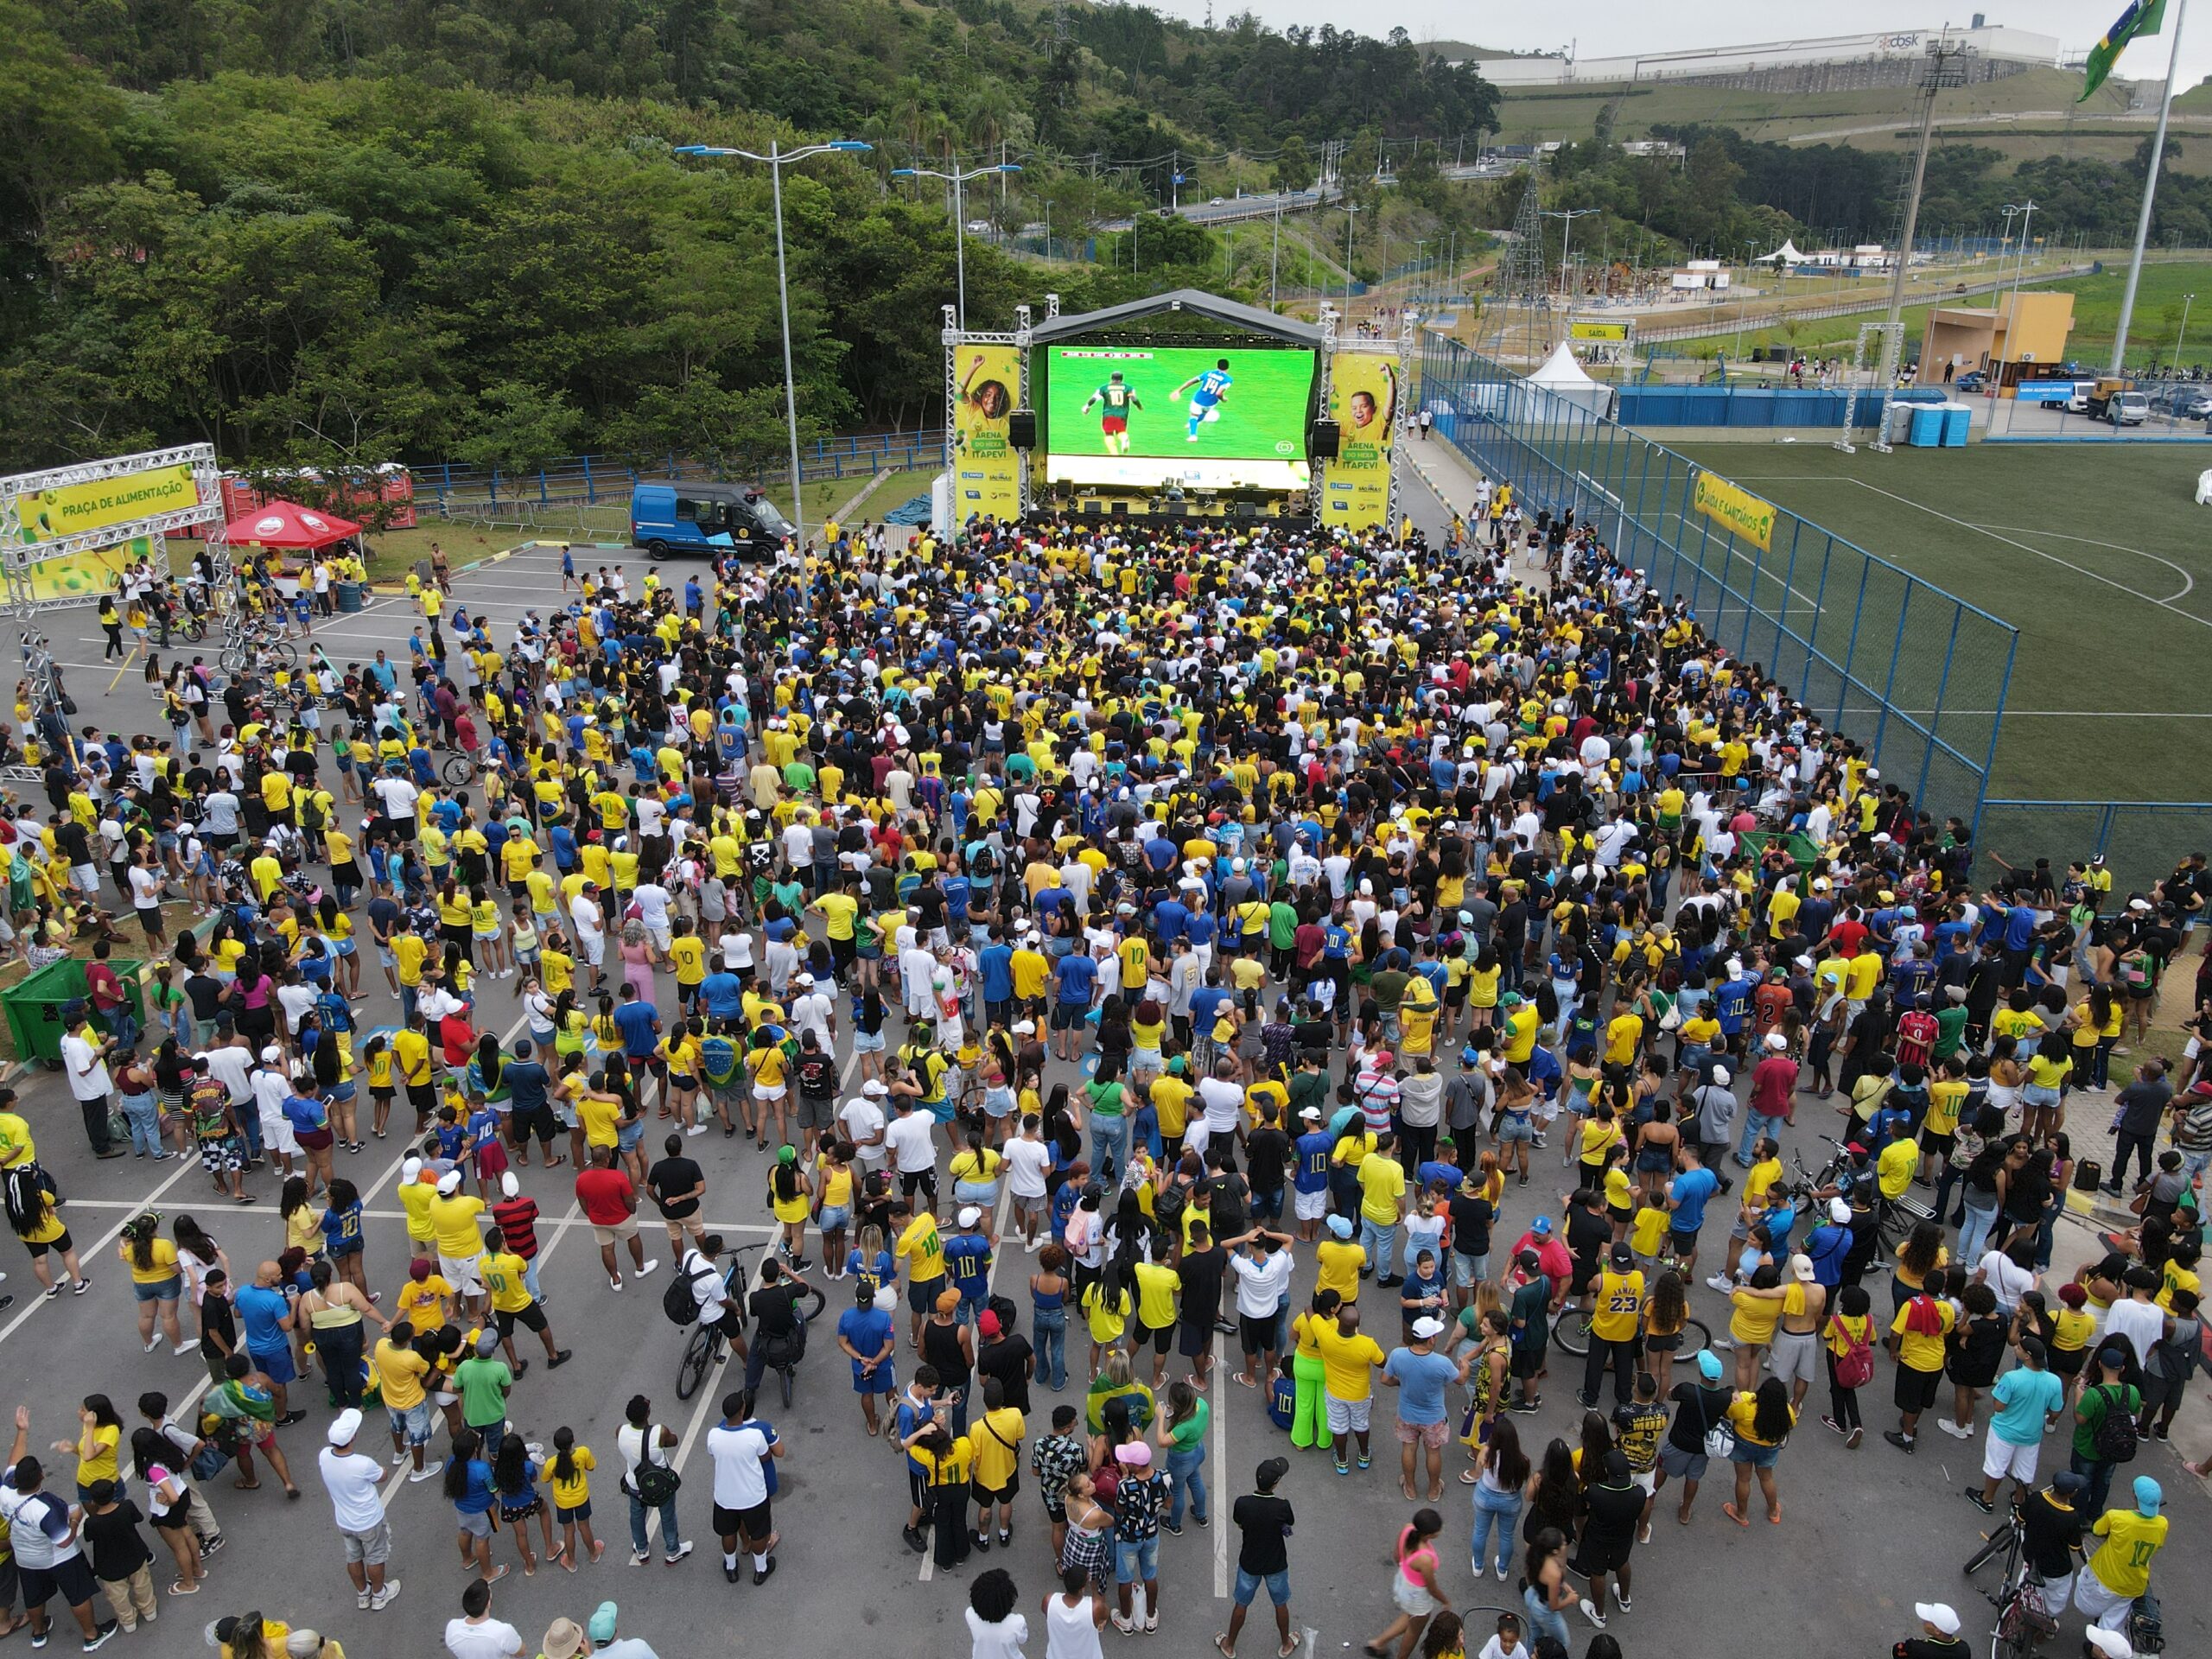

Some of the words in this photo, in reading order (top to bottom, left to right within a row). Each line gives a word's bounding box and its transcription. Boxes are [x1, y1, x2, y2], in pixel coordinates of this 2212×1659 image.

[1588, 327, 1606, 337] SAÍDA
[1202, 378, 1219, 394] 14
[1109, 391, 1124, 405] 10
[62, 500, 98, 517] PRAÇA
[99, 497, 113, 509] DE
[115, 480, 182, 506] ALIMENTAÇÃO
[995, 691, 1005, 703] 10
[1026, 721, 1032, 732] 9
[721, 734, 733, 747] 10
[1363, 732, 1374, 743] 10
[1238, 774, 1249, 789] 10
[473, 911, 486, 921] 10
[1329, 933, 1339, 948] 10
[678, 950, 693, 964] 10
[1132, 947, 1144, 964] 10
[1414, 979, 1431, 991] 11
[1913, 976, 1925, 993] 11
[1729, 998, 1745, 1017] 10
[1763, 1004, 1773, 1023] 2
[321, 1009, 334, 1027] 11
[2010, 1022, 2026, 1035] 10
[374, 1060, 385, 1075] 10
[1943, 1095, 1964, 1118] 10
[479, 1125, 493, 1141] 10
[1311, 1152, 1326, 1173] 10
[1906, 1157, 1917, 1180] 10
[342, 1215, 359, 1239] 10
[921, 1230, 940, 1258] 10
[958, 1256, 977, 1279] 10
[486, 1273, 506, 1293] 10
[1612, 1287, 1637, 1297] JAMES
[1609, 1296, 1638, 1314] 23
[1278, 1393, 1293, 1414] 10
[561, 1468, 581, 1491] 10
[2127, 1540, 2155, 1567] 10
